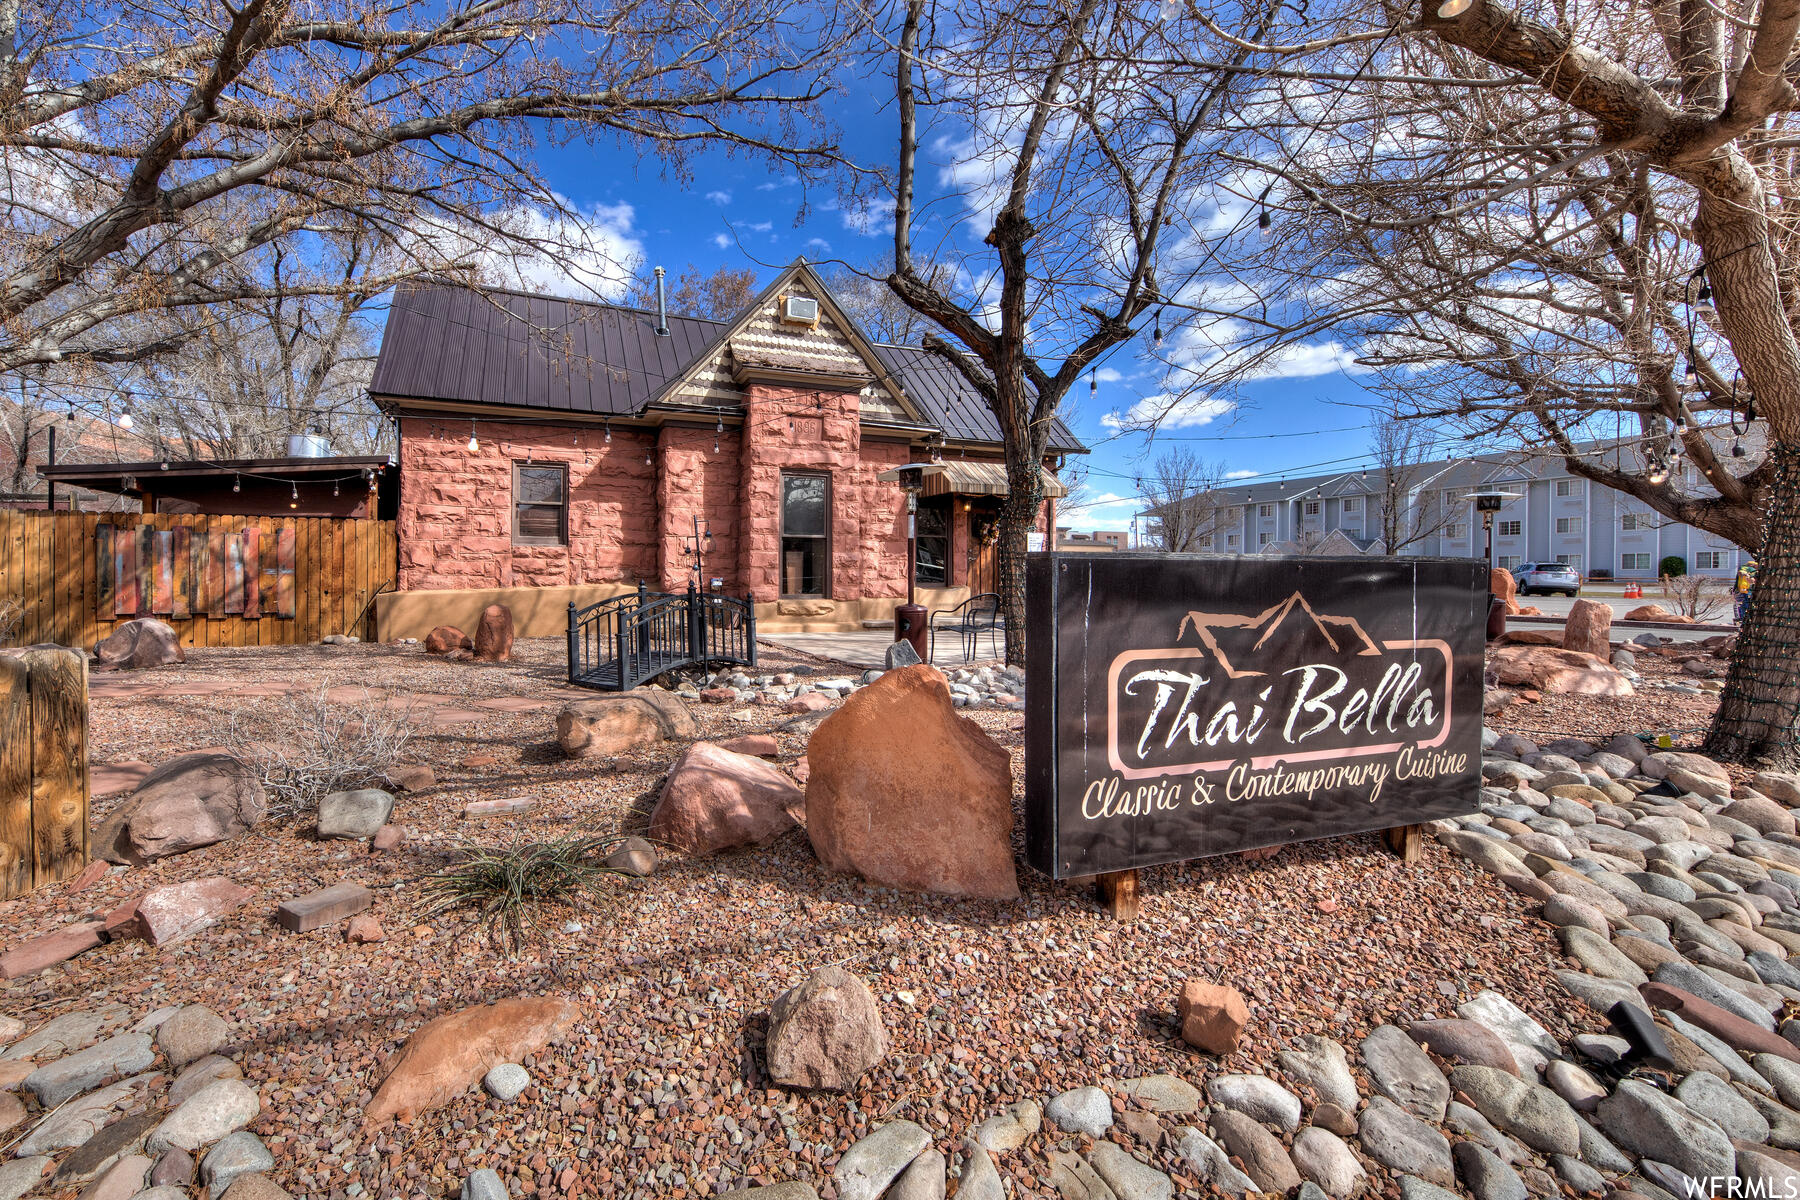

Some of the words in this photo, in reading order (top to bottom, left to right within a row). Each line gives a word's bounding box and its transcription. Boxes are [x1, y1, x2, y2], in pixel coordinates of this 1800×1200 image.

[1125, 669, 1272, 759] Thai
[1282, 662, 1439, 744] Bella
[1081, 776, 1182, 820] Classic
[1191, 775, 1216, 806] &
[1226, 763, 1391, 803] Contemporary
[1395, 745, 1467, 781] Cuisine
